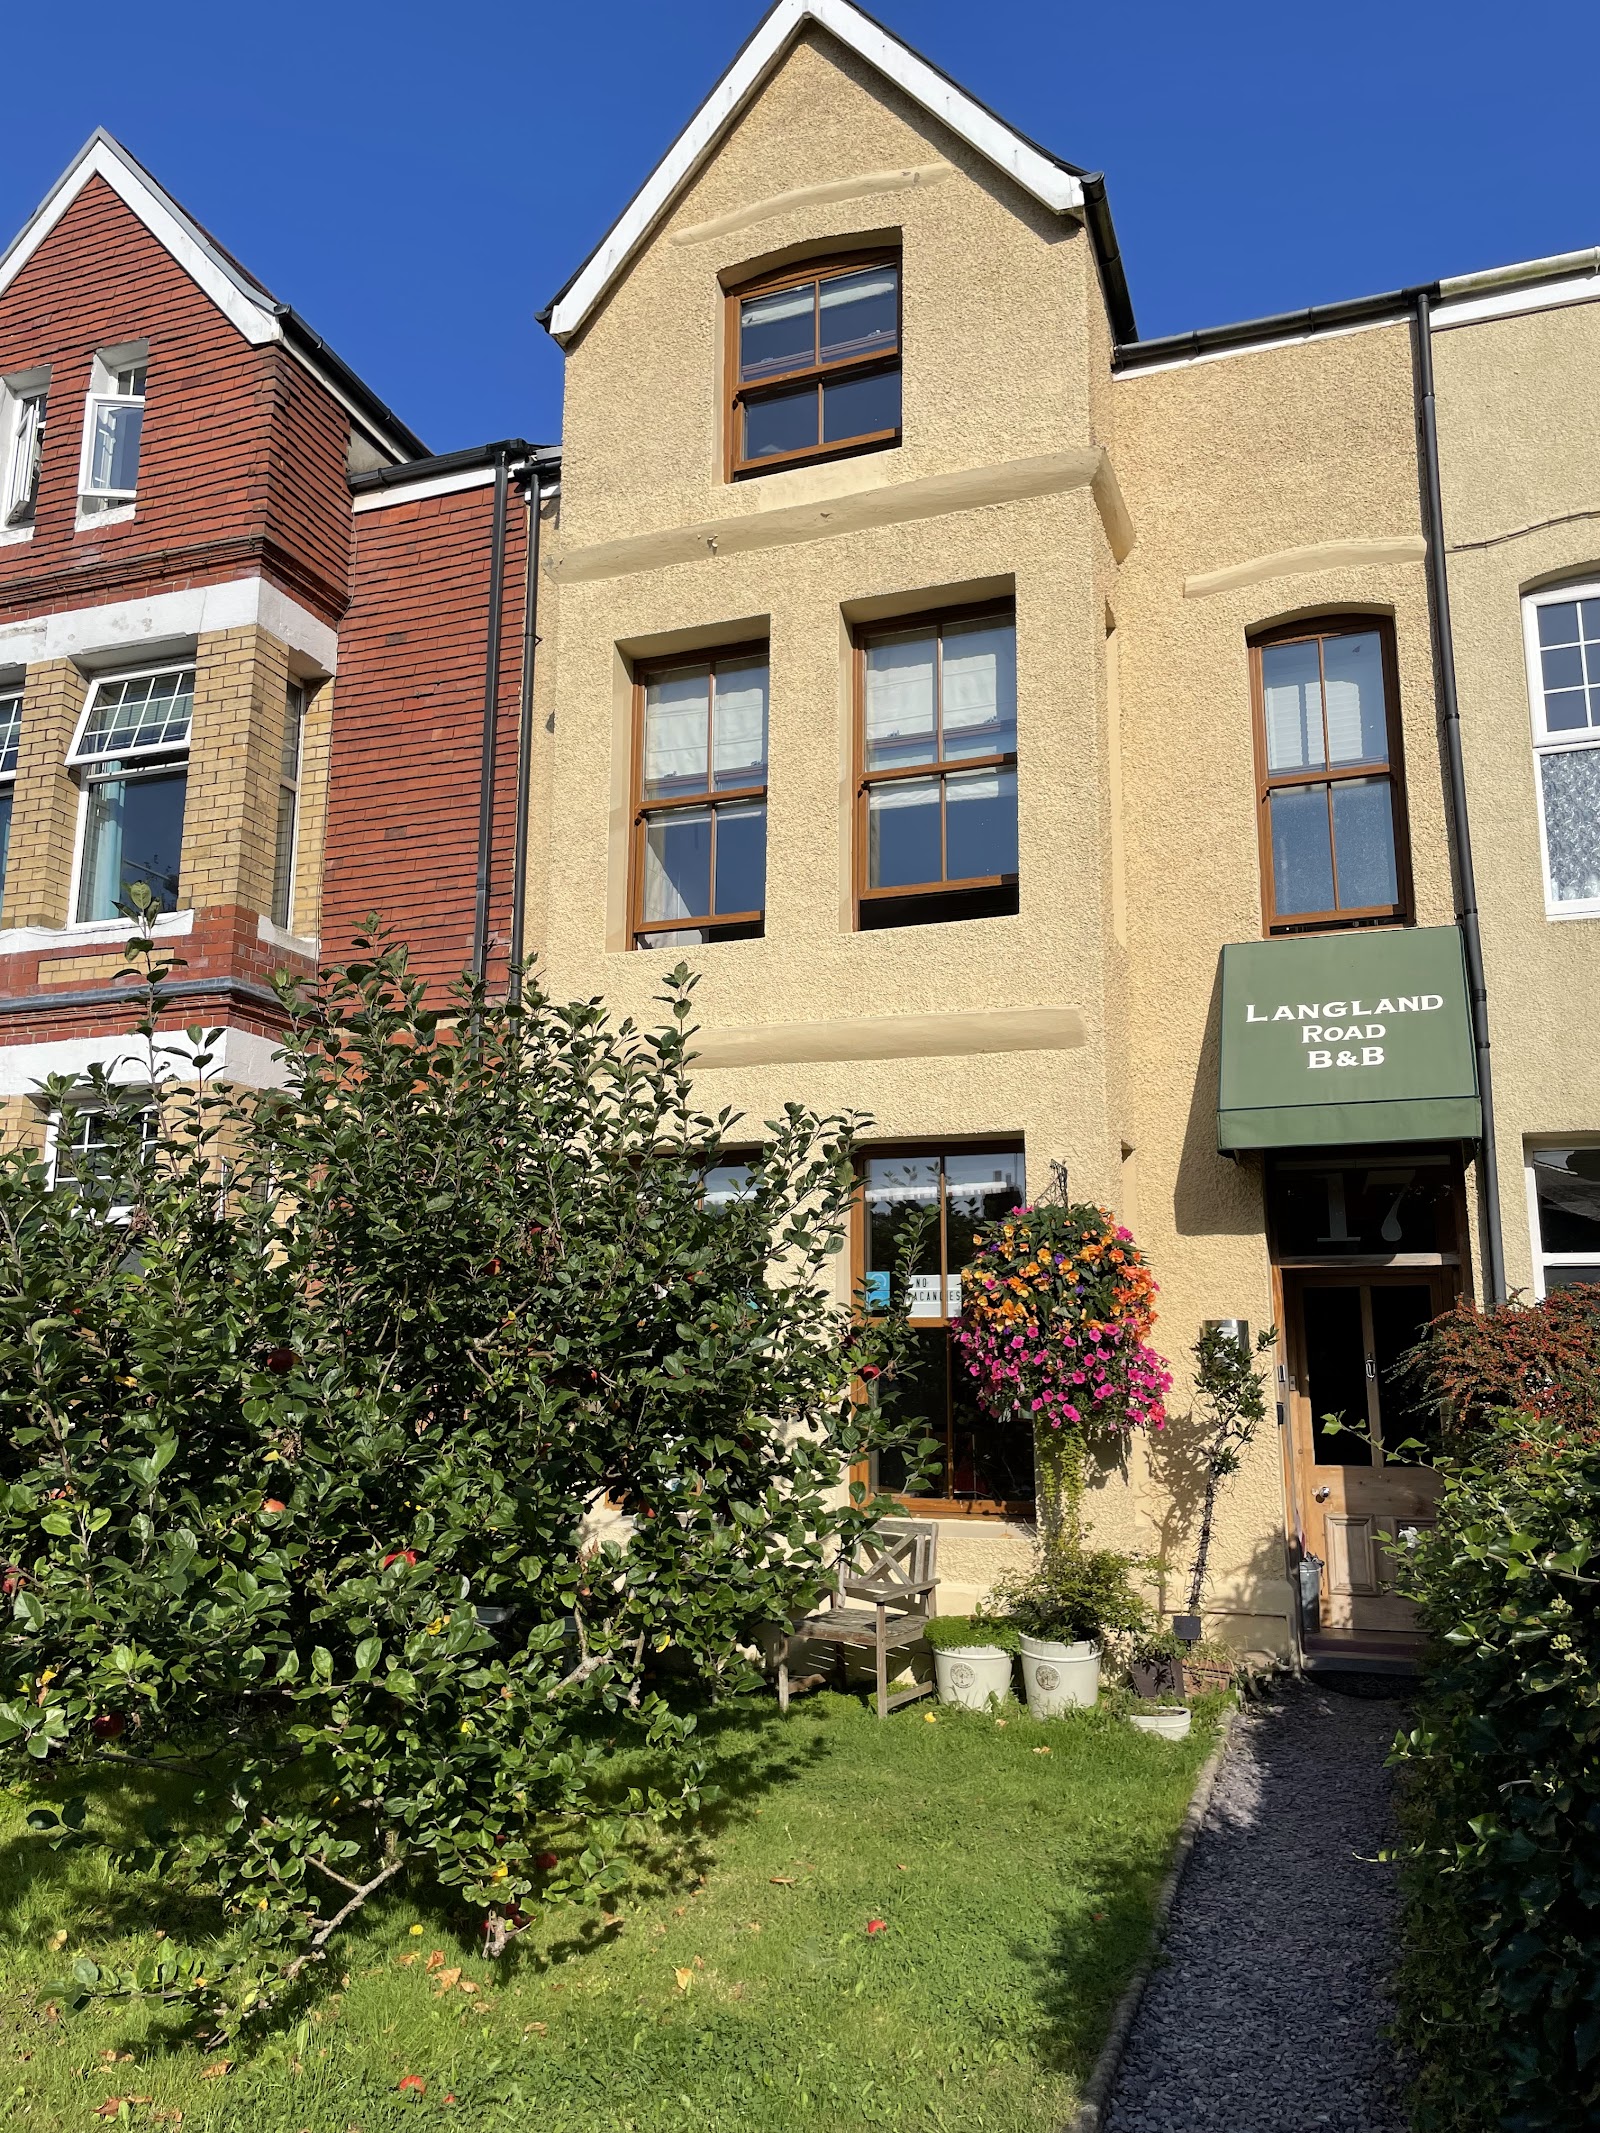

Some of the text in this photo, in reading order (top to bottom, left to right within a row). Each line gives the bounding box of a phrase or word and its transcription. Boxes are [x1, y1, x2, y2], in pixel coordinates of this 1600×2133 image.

[1246, 994, 1444, 1022] LANGLAND
[1301, 1023, 1386, 1044] ROAD
[1307, 1046, 1385, 1069] B&B
[1313, 1169, 1416, 1242] 17
[915, 1278, 927, 1288] NO
[905, 1291, 961, 1301] ACANCES
